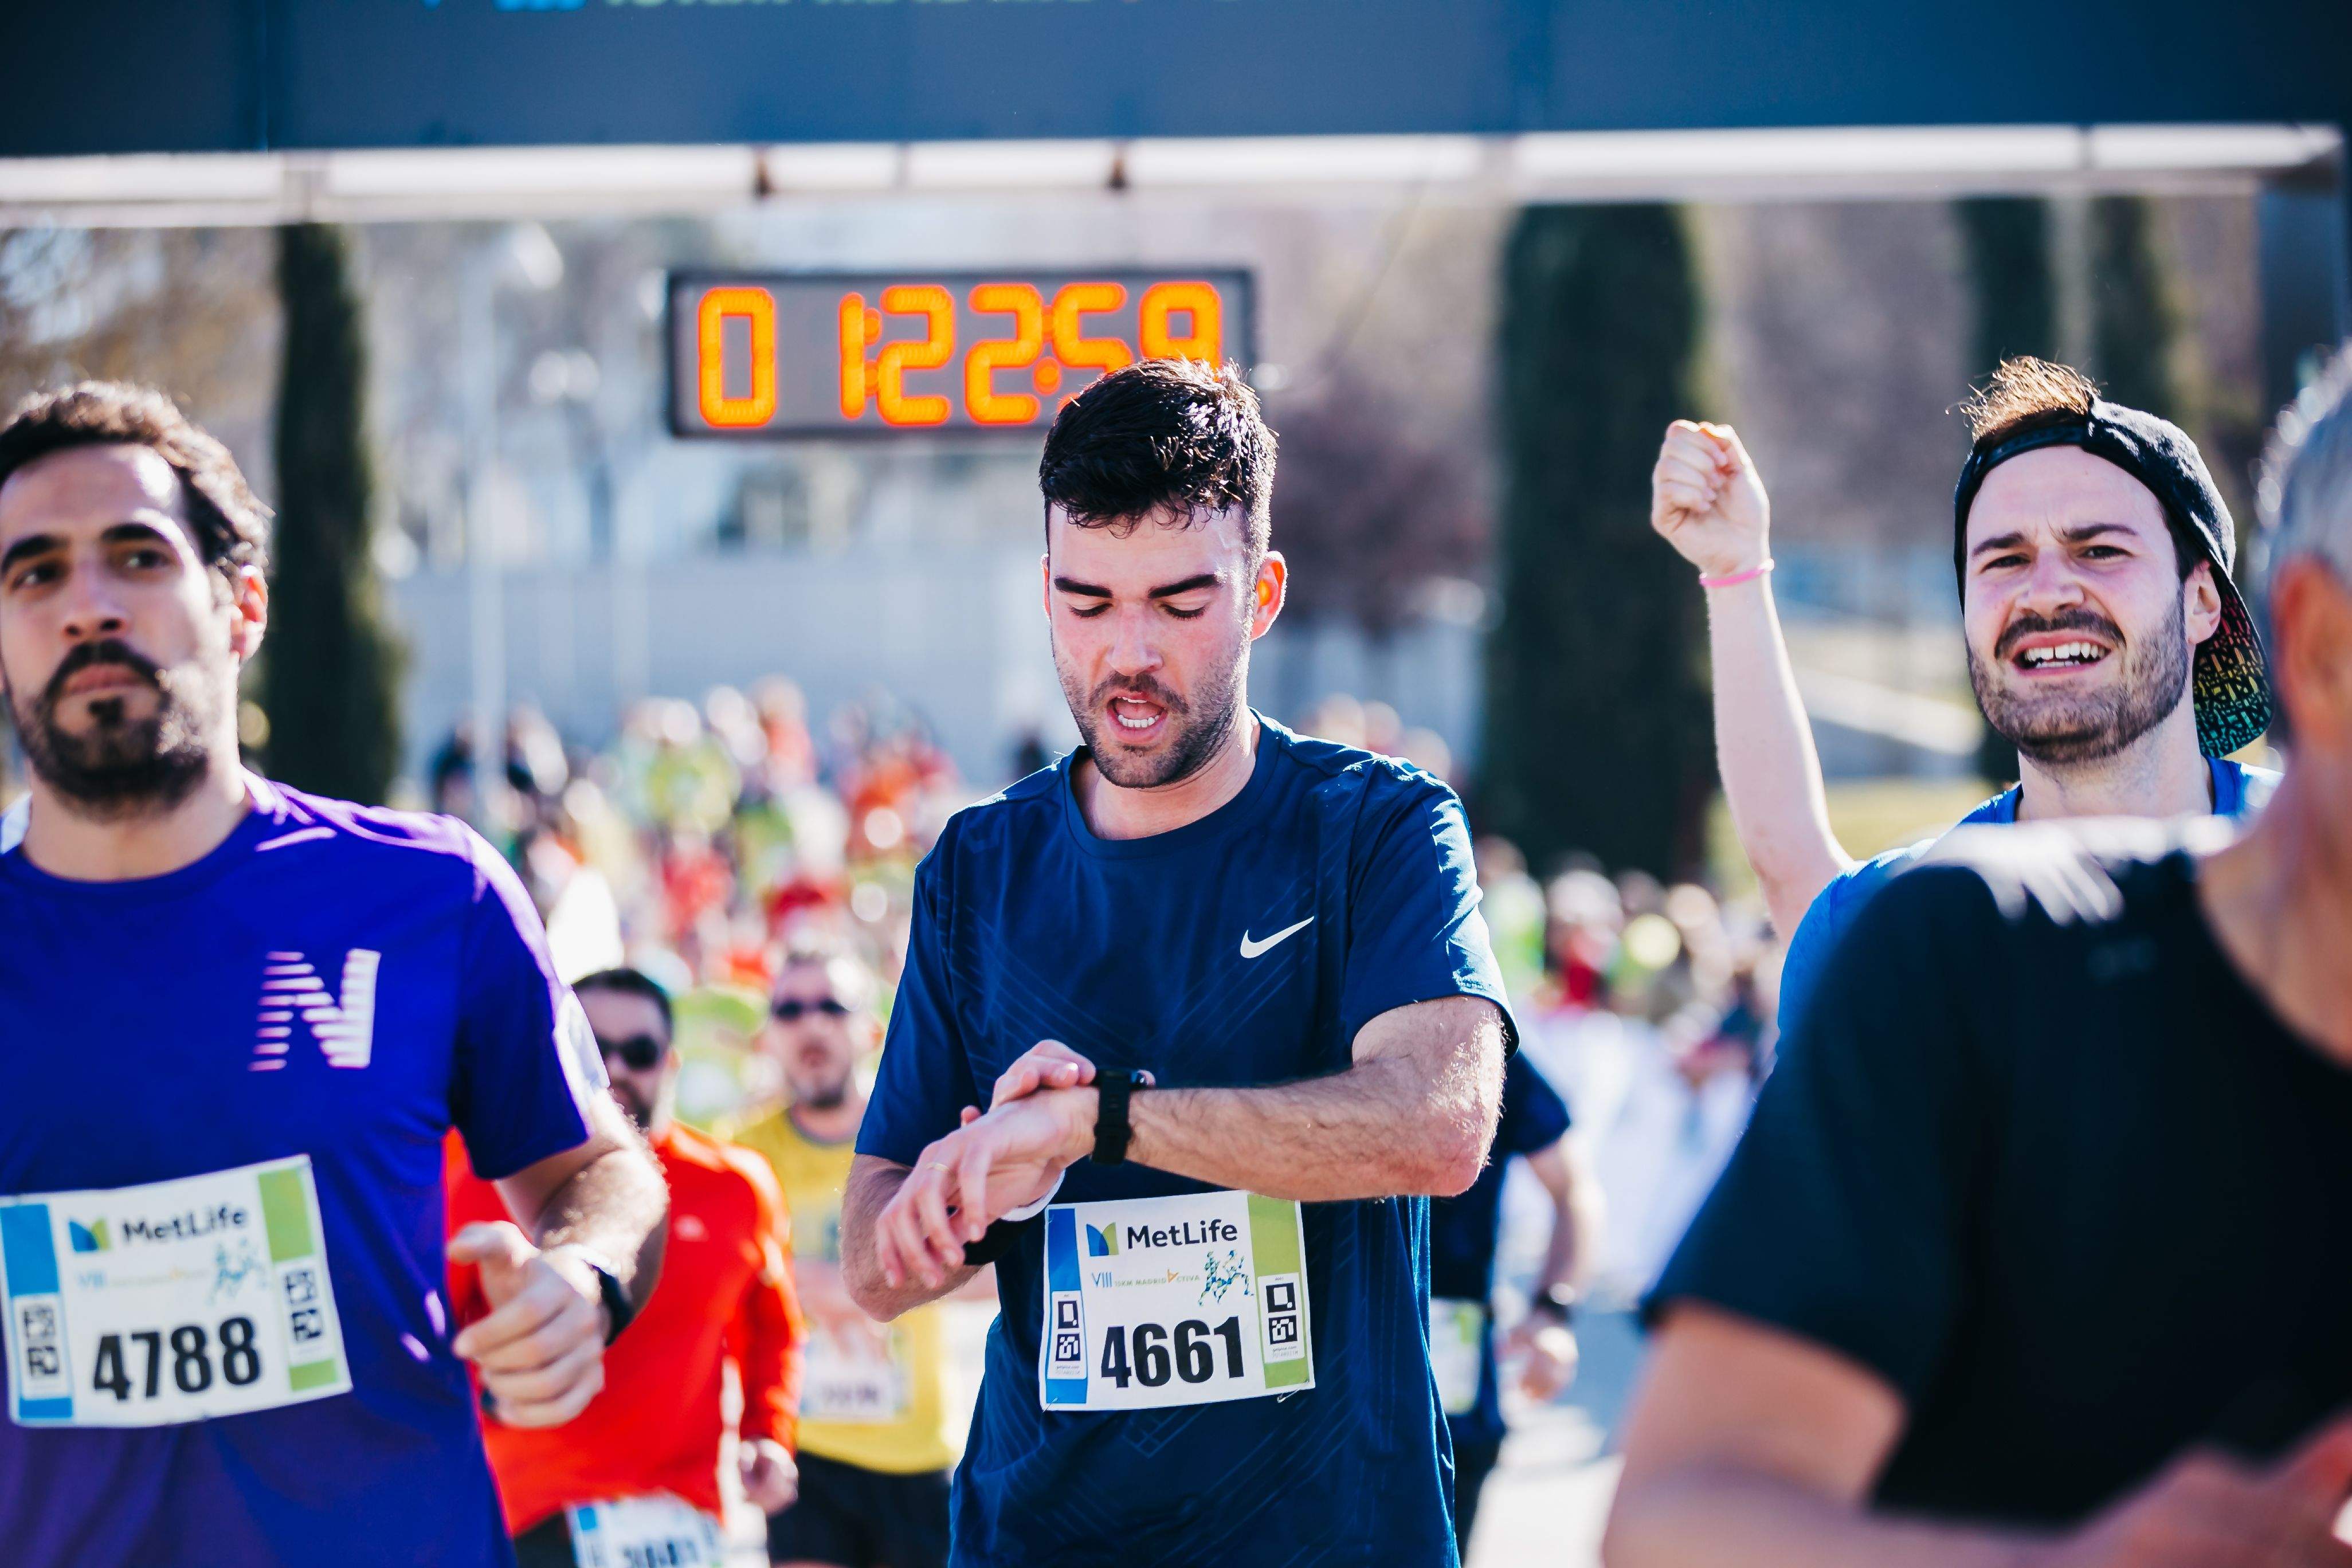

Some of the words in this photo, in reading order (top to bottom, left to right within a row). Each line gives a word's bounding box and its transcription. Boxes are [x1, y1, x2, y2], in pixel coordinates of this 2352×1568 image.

[121, 1205, 248, 1244] MetLife
[1127, 1218, 1238, 1249] MetLife
[1091, 1271, 1113, 1288] VIII
[93, 1316, 261, 1401] 4788
[1100, 1315, 1245, 1389] 4661
